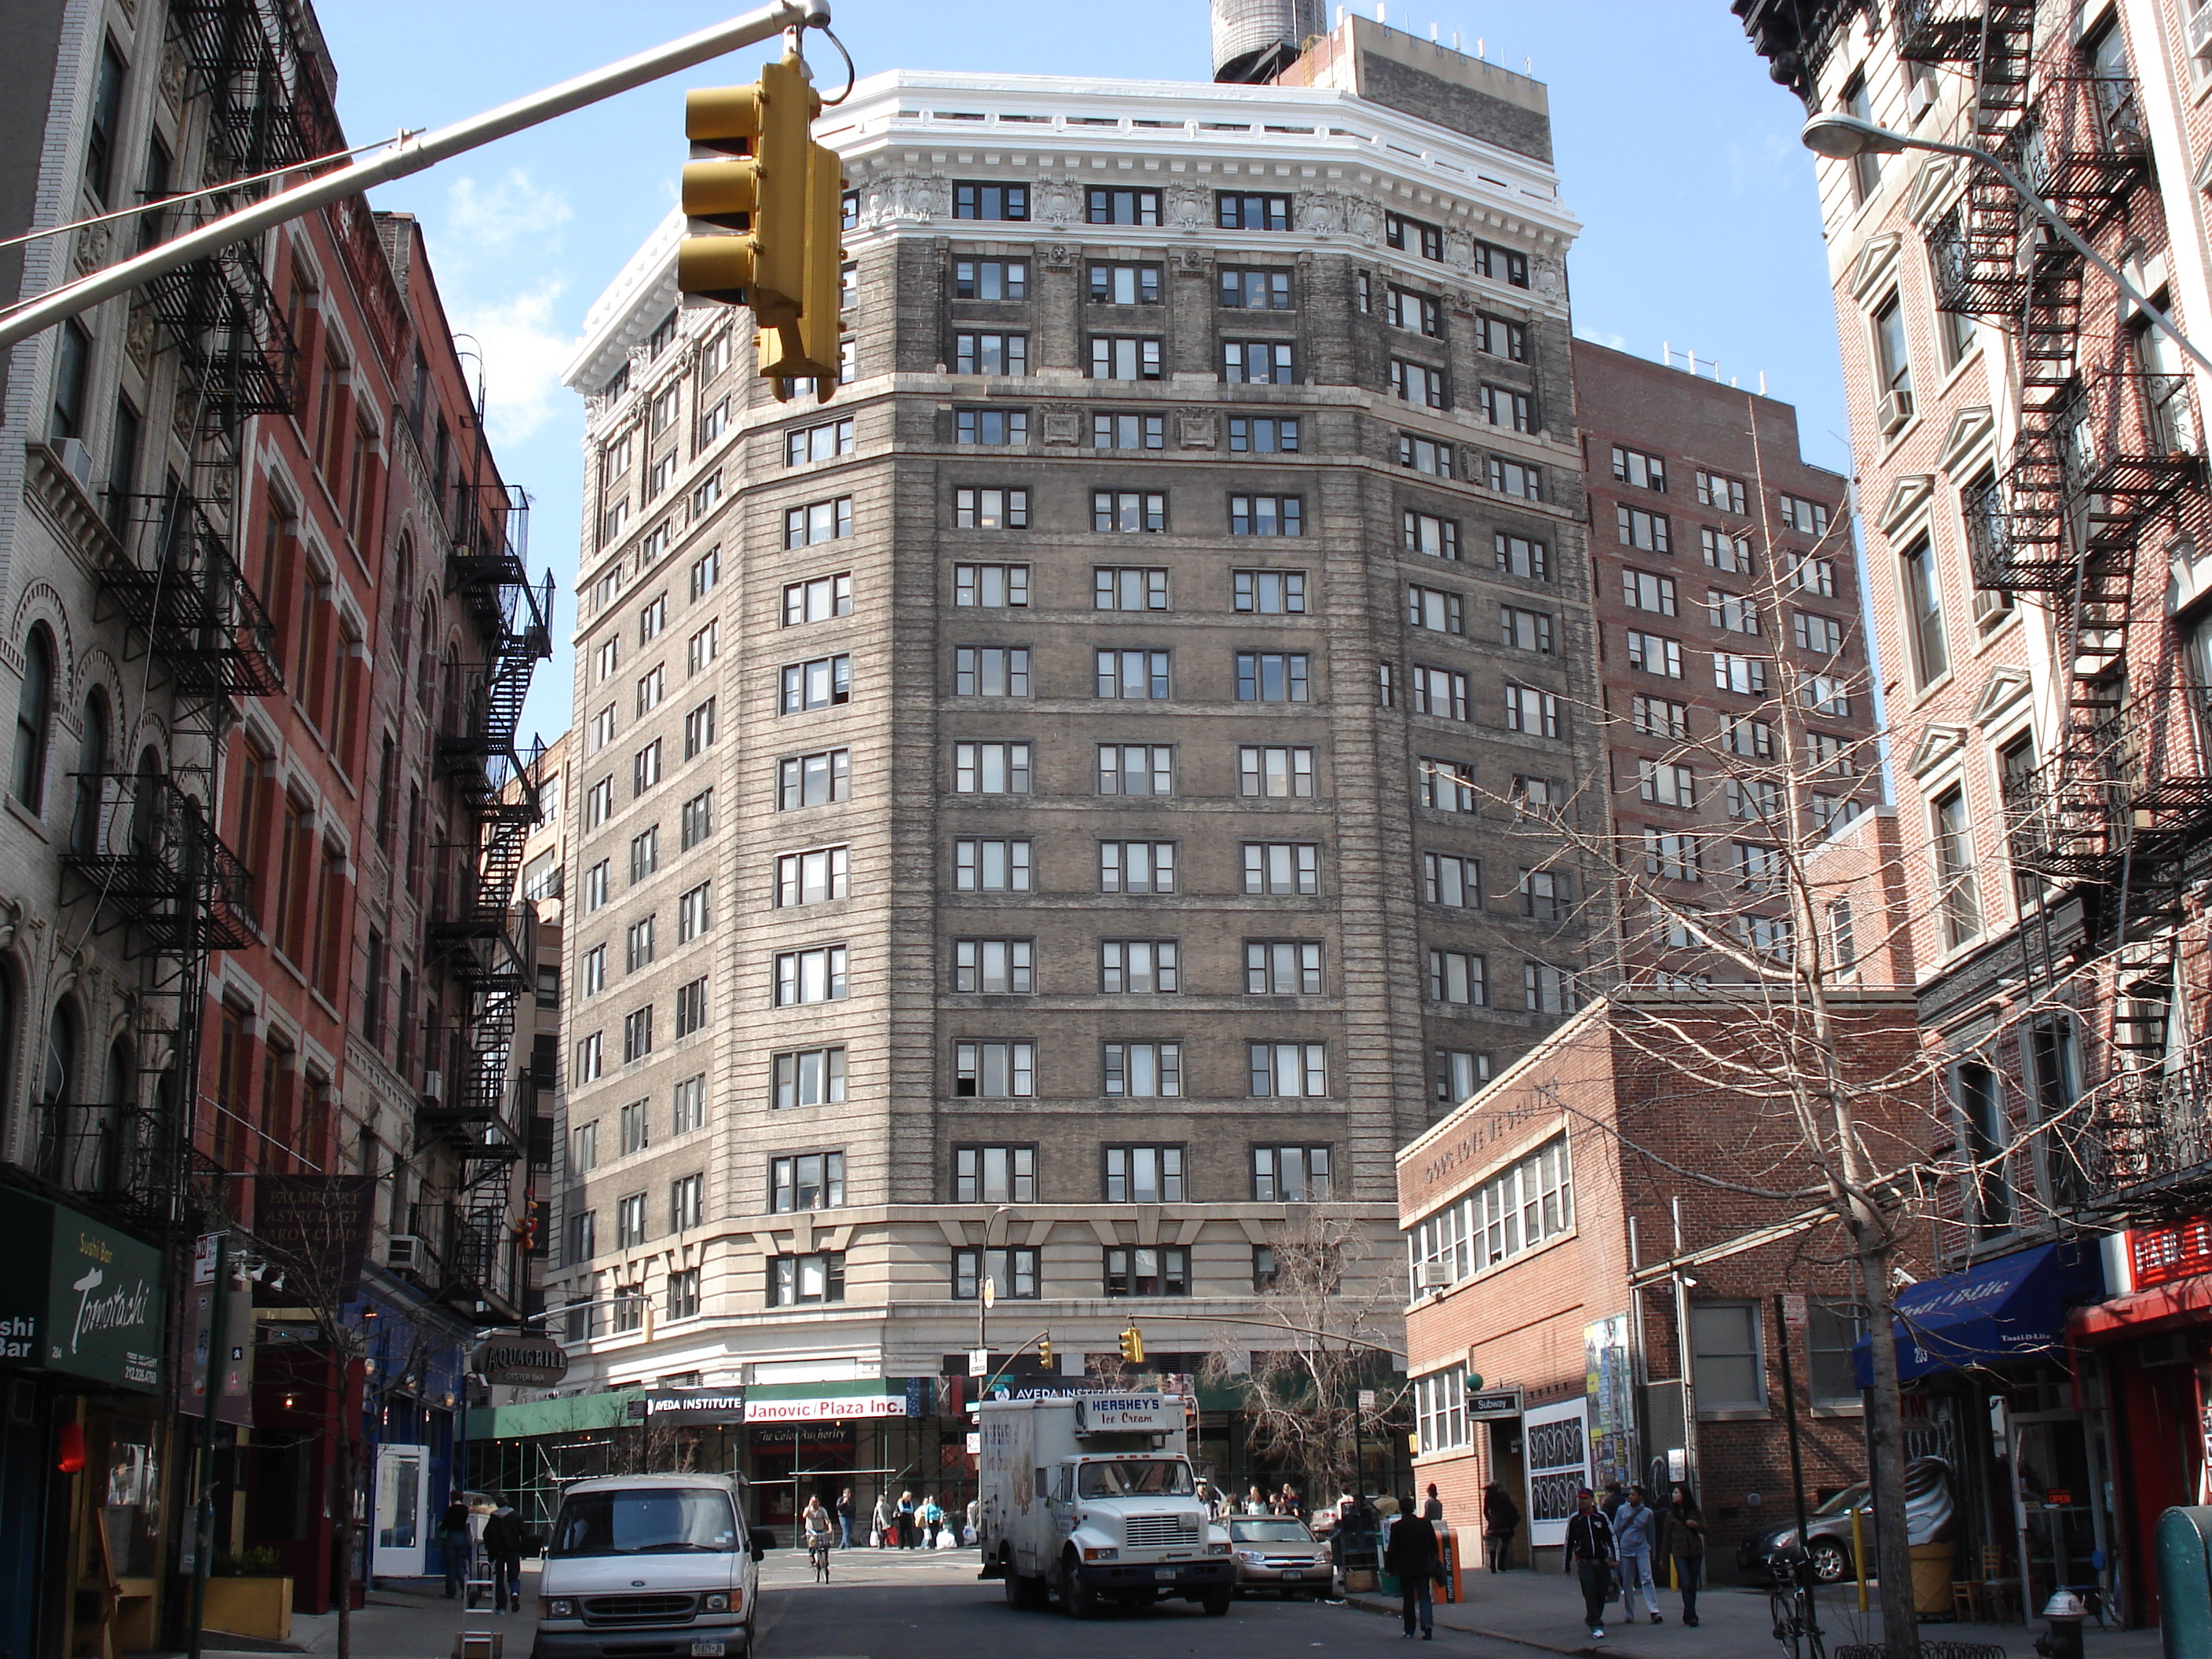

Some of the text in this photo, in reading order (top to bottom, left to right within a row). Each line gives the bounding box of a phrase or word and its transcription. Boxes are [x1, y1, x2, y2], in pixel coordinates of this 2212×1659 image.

[1457, 1128, 1484, 1163] LOVE
[1488, 1115, 1503, 1142] WE
[266, 1210, 361, 1222] ASTROLOGY
[79, 1232, 113, 1263] Sushi Bar
[196, 1238, 207, 1258] NO
[0, 1338, 32, 1358] Bar
[487, 1346, 566, 1372] AQUAGRILL
[506, 1372, 545, 1382] OYSTER BAR
[1016, 1389, 1060, 1399] AVEDA
[655, 1397, 742, 1412] AVEDA INSTITUTE
[870, 1398, 905, 1413] Inc.
[1093, 1398, 1159, 1412] HERSHEY'S
[1478, 1397, 1507, 1410] Subway
[1900, 1394, 1928, 1418] TM
[1102, 1412, 1153, 1424] Ice Cream
[775, 1429, 798, 1441] Colo
